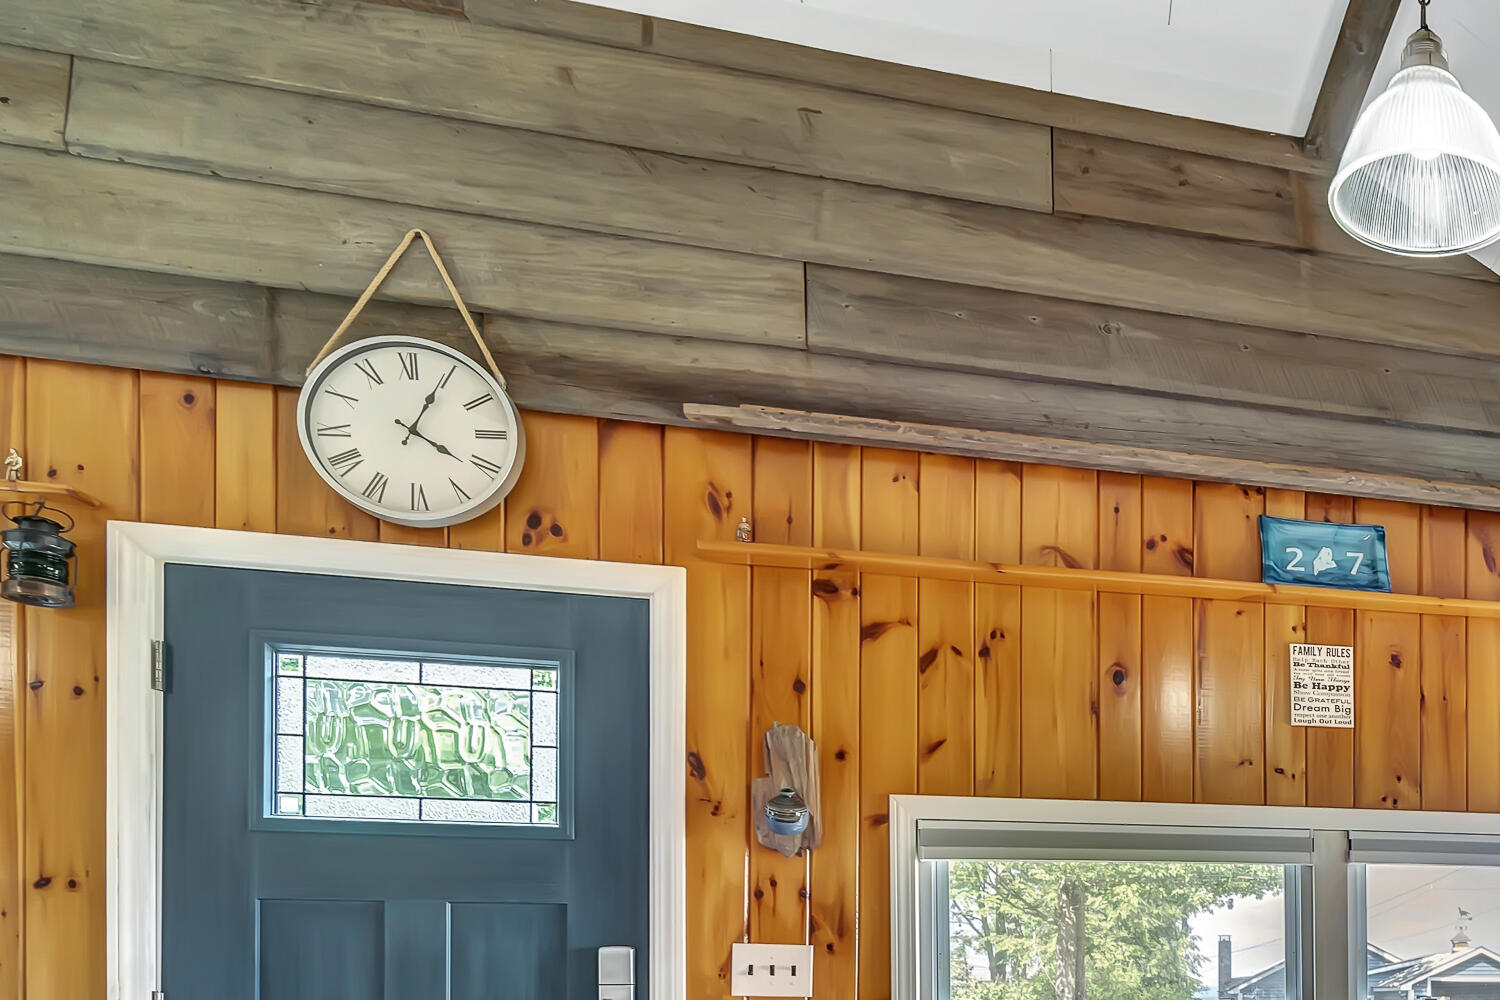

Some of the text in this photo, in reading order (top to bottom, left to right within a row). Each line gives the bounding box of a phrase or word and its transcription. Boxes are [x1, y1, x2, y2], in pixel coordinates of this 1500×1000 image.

[354, 358, 384, 390] XI
[397, 352, 419, 381] XII
[440, 365, 458, 389] I
[325, 384, 359, 409] X
[462, 393, 493, 411] II
[317, 422, 351, 437] IX
[474, 429, 507, 440] III
[327, 448, 365, 477] VIII
[469, 454, 501, 480] IV
[361, 471, 389, 504] VII
[410, 482, 430, 511] VI
[448, 477, 472, 504] V
[1285, 547, 1364, 575] 2 7
[1293, 646, 1351, 658] FAMILY RULES
[1312, 682, 1350, 692] Happy
[1294, 703, 1351, 715] Dream Big
